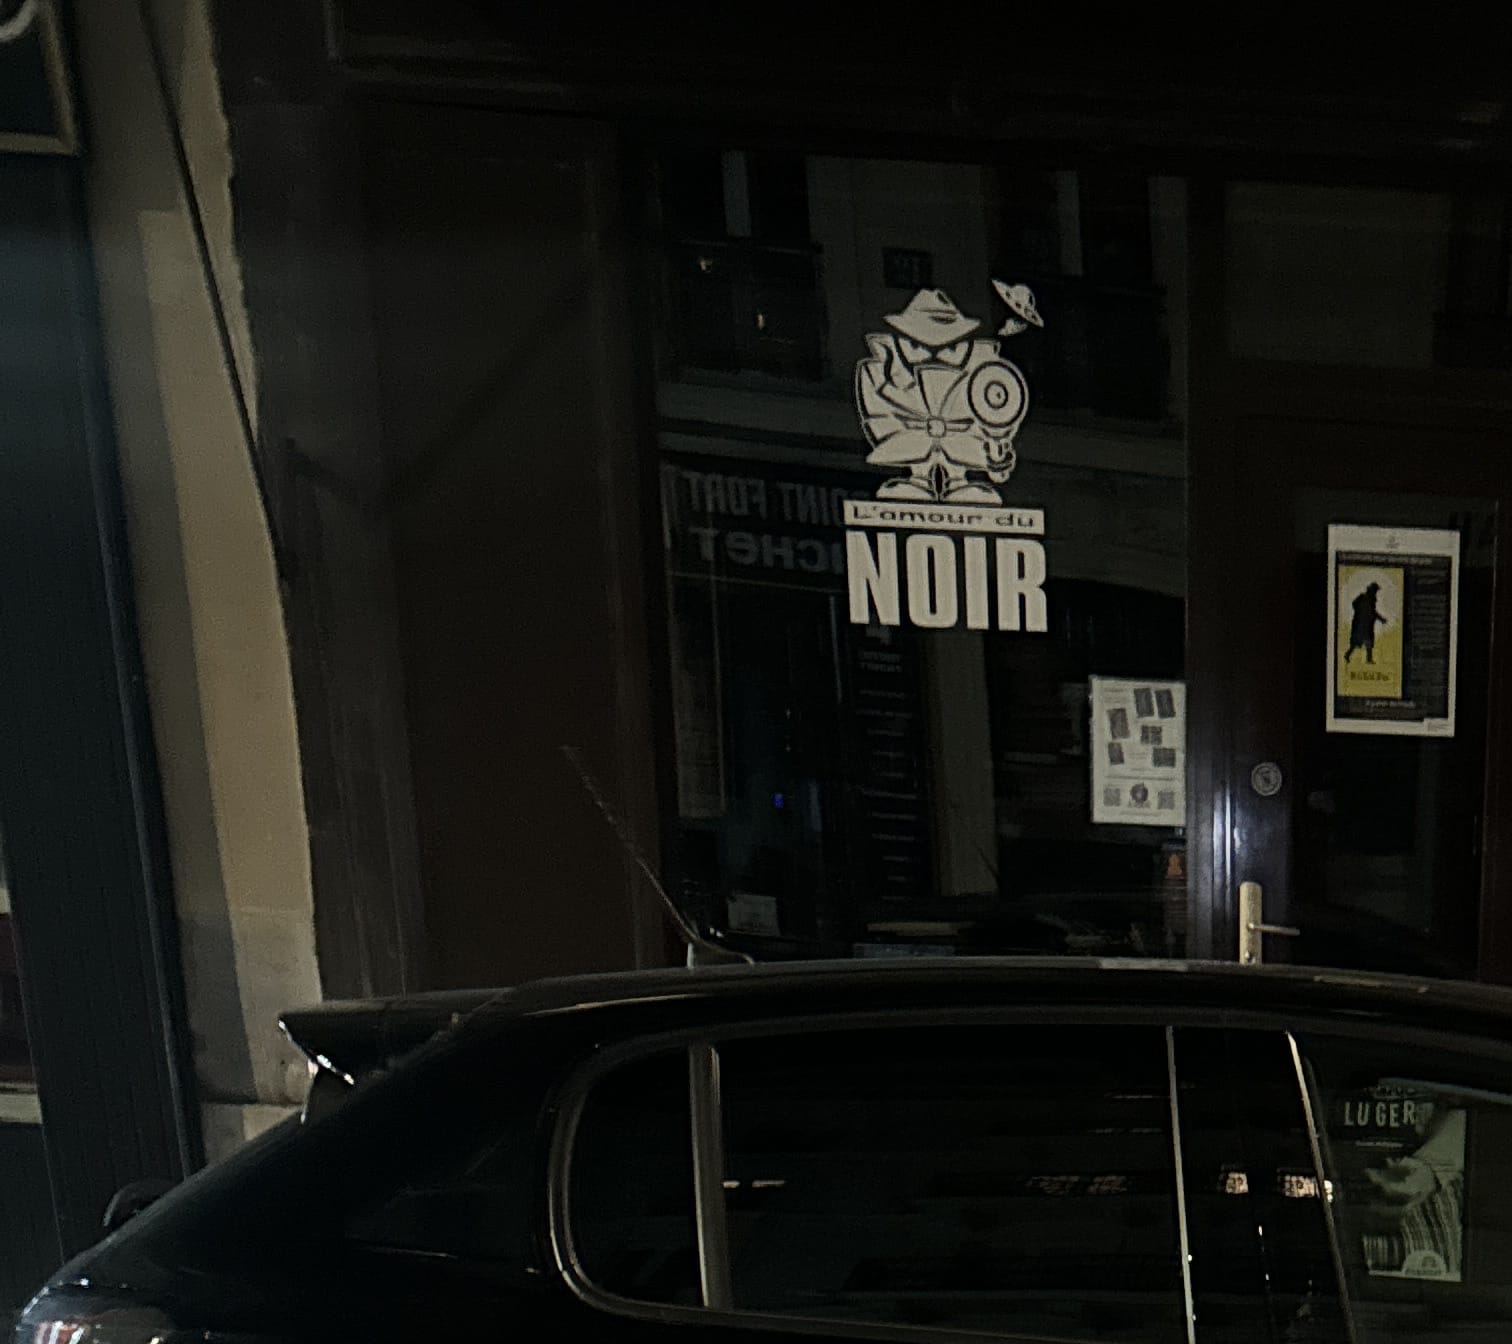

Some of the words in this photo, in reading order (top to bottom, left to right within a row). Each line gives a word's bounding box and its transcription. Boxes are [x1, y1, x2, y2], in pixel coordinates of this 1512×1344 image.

[853, 504, 982, 526] L'amour
[995, 511, 1034, 528] du
[845, 529, 1049, 633] NOIR
[1344, 1100, 1417, 1129] LUGER
